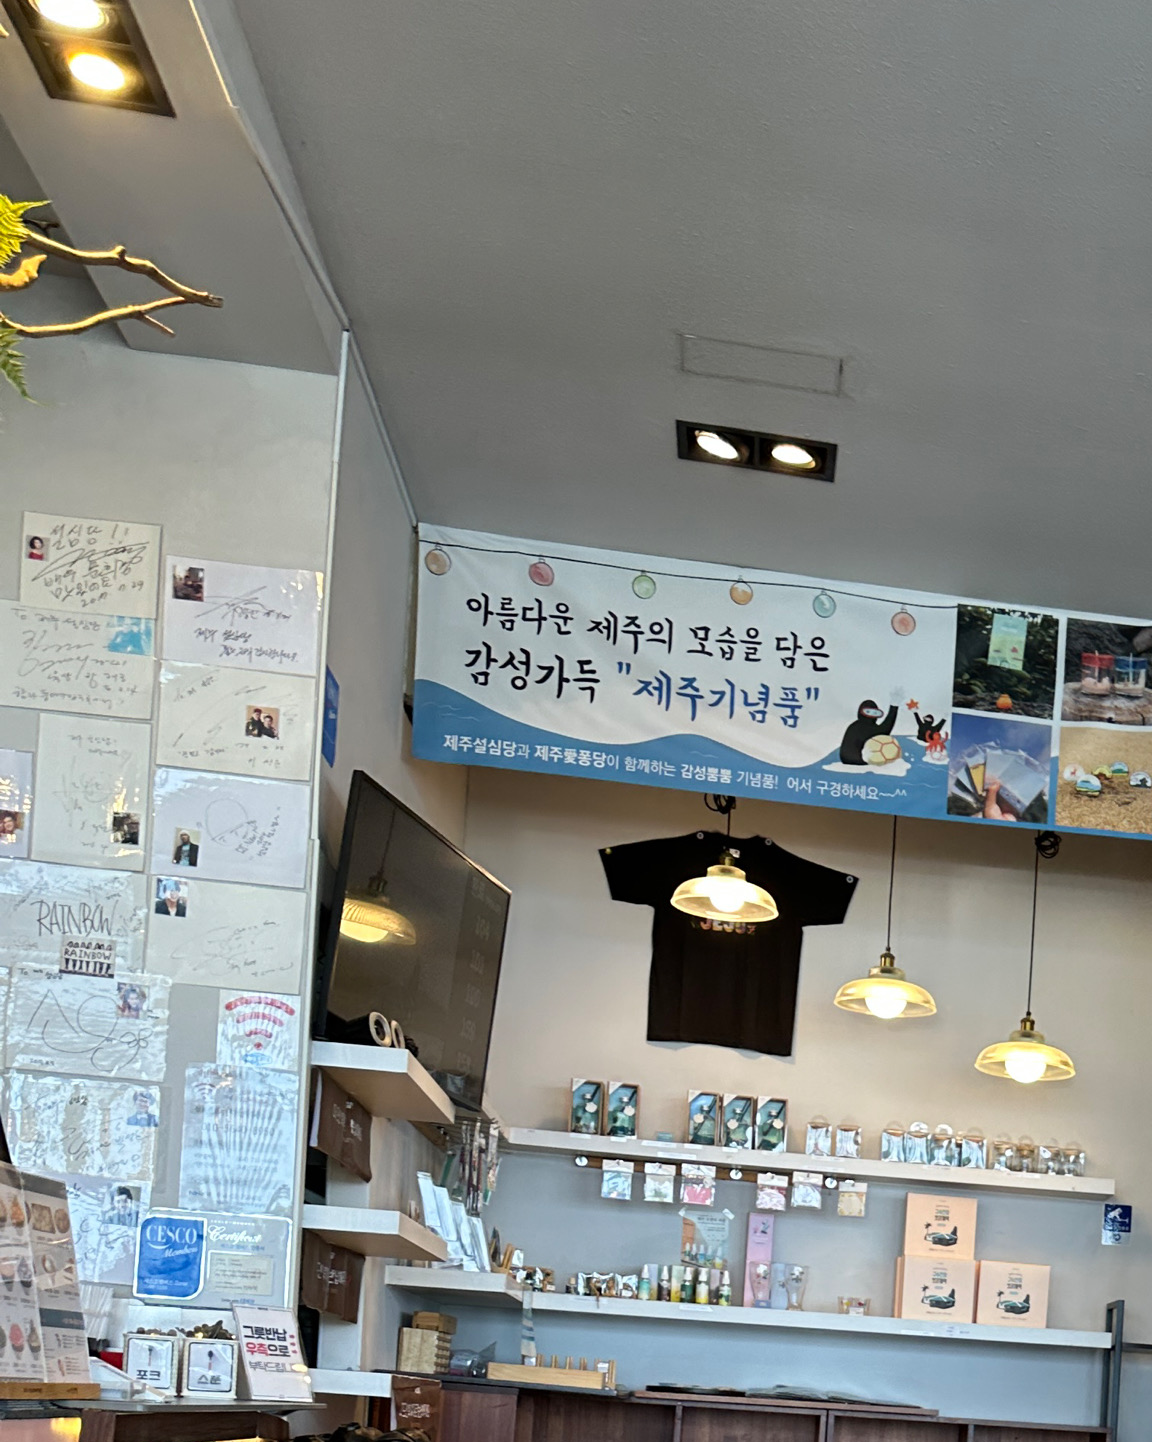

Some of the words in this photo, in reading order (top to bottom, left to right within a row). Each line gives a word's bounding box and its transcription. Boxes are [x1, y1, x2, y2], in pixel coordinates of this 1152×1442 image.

[466, 592, 574, 635] 아름다운
[586, 610, 674, 655] 제주의
[687, 626, 763, 662] 모습을
[775, 631, 830, 672] 담은
[464, 641, 601, 704] 감성가득
[616, 661, 820, 729] "제주기념품"
[443, 734, 531, 759] 제주설심당과
[534, 744, 620, 770] 제주愛퐁당이
[624, 756, 677, 777] 함께하는
[736, 771, 778, 790] 기념품!
[786, 777, 812, 794] 어서
[31, 900, 119, 937] RAINBOW
[64, 948, 112, 961] RAINBOW
[146, 1225, 198, 1245] CESCO
[242, 1324, 288, 1343] 그릇반납
[245, 1341, 292, 1358] 우측으로
[136, 1369, 161, 1382] 포크
[197, 1374, 222, 1386] 스푼
